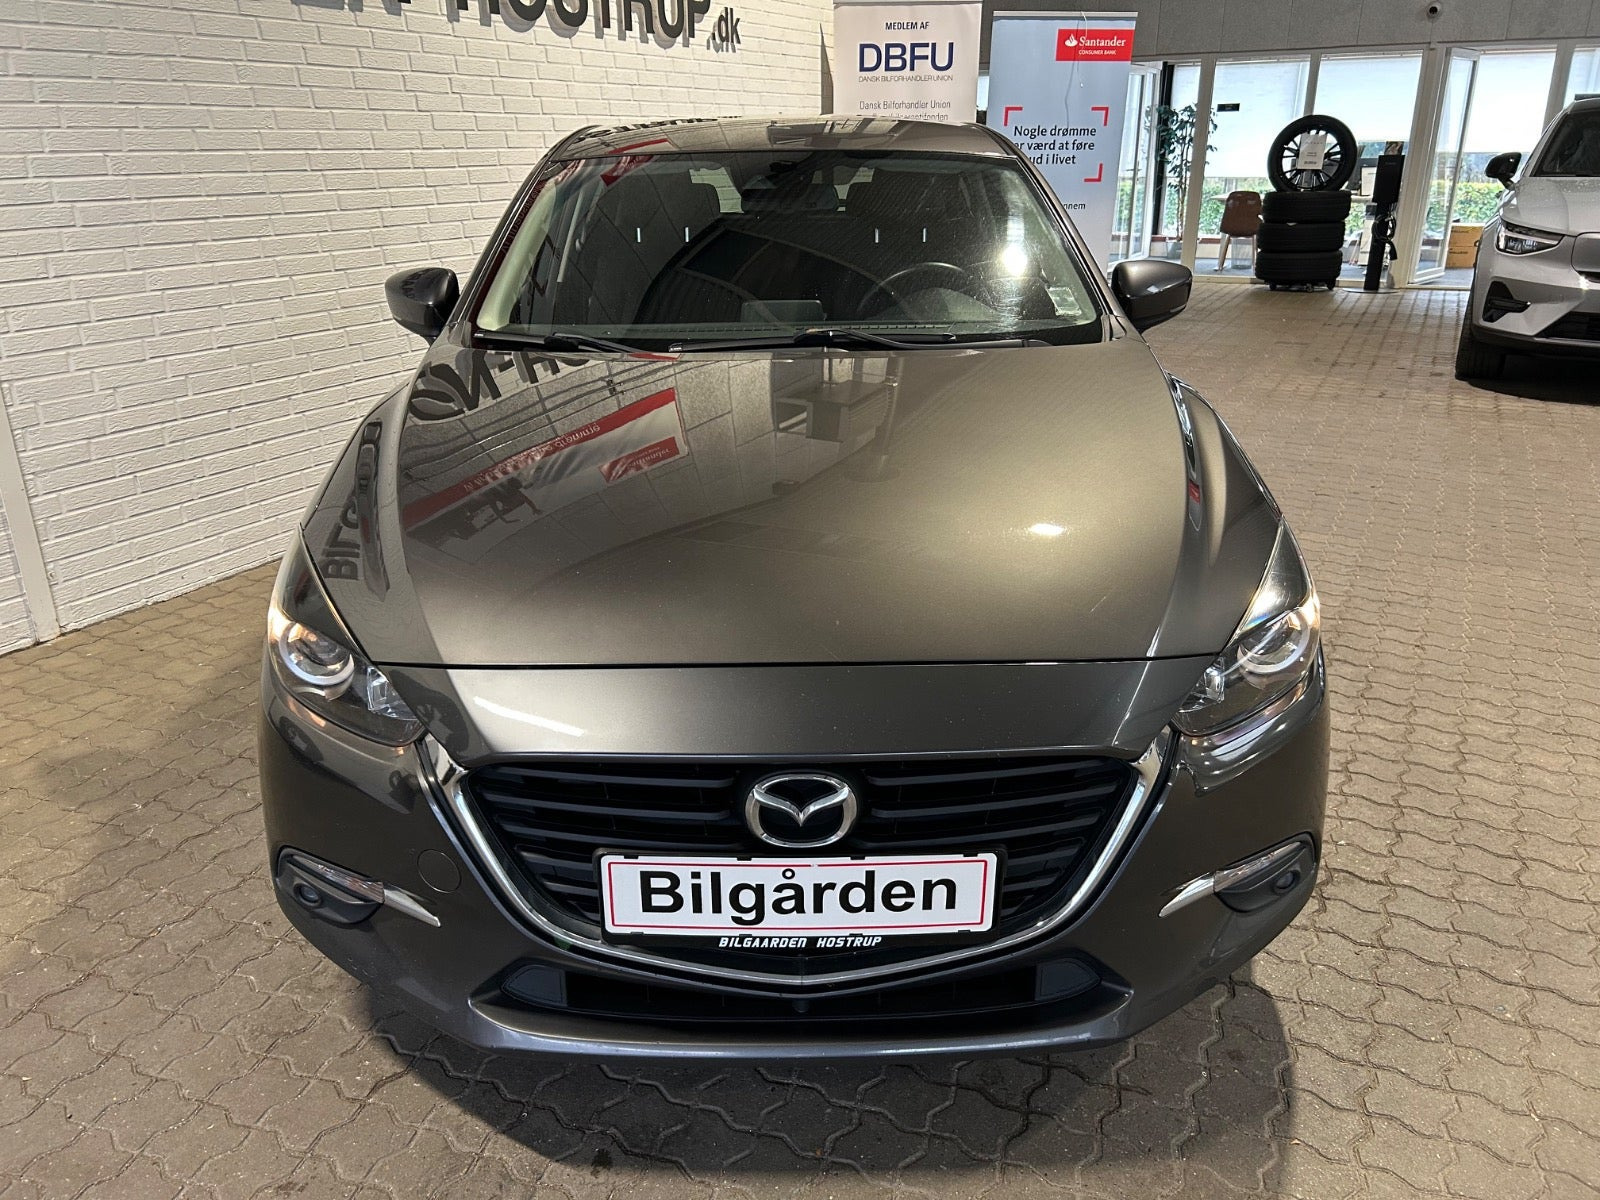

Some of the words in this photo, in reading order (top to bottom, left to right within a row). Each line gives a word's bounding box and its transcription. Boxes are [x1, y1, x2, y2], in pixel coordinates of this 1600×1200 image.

[885, 22, 918, 30] MEDLEM
[920, 22, 930, 30] AF
[1079, 36, 1126, 47] Santander
[859, 42, 954, 72] DBFU
[860, 101, 881, 110] Dansk
[883, 100, 928, 110] Bilforhandler
[931, 100, 951, 109] Union
[1014, 125, 1047, 139] Nogle
[1049, 125, 1097, 137] drømme
[1027, 140, 1056, 151] værd
[1058, 141, 1070, 150] at
[1072, 139, 1095, 151] føre
[1051, 154, 1076, 165] livet
[639, 868, 957, 926] Bilgården
[718, 937, 807, 948] BILGAARDEN
[816, 936, 882, 948] HOSTRUP
